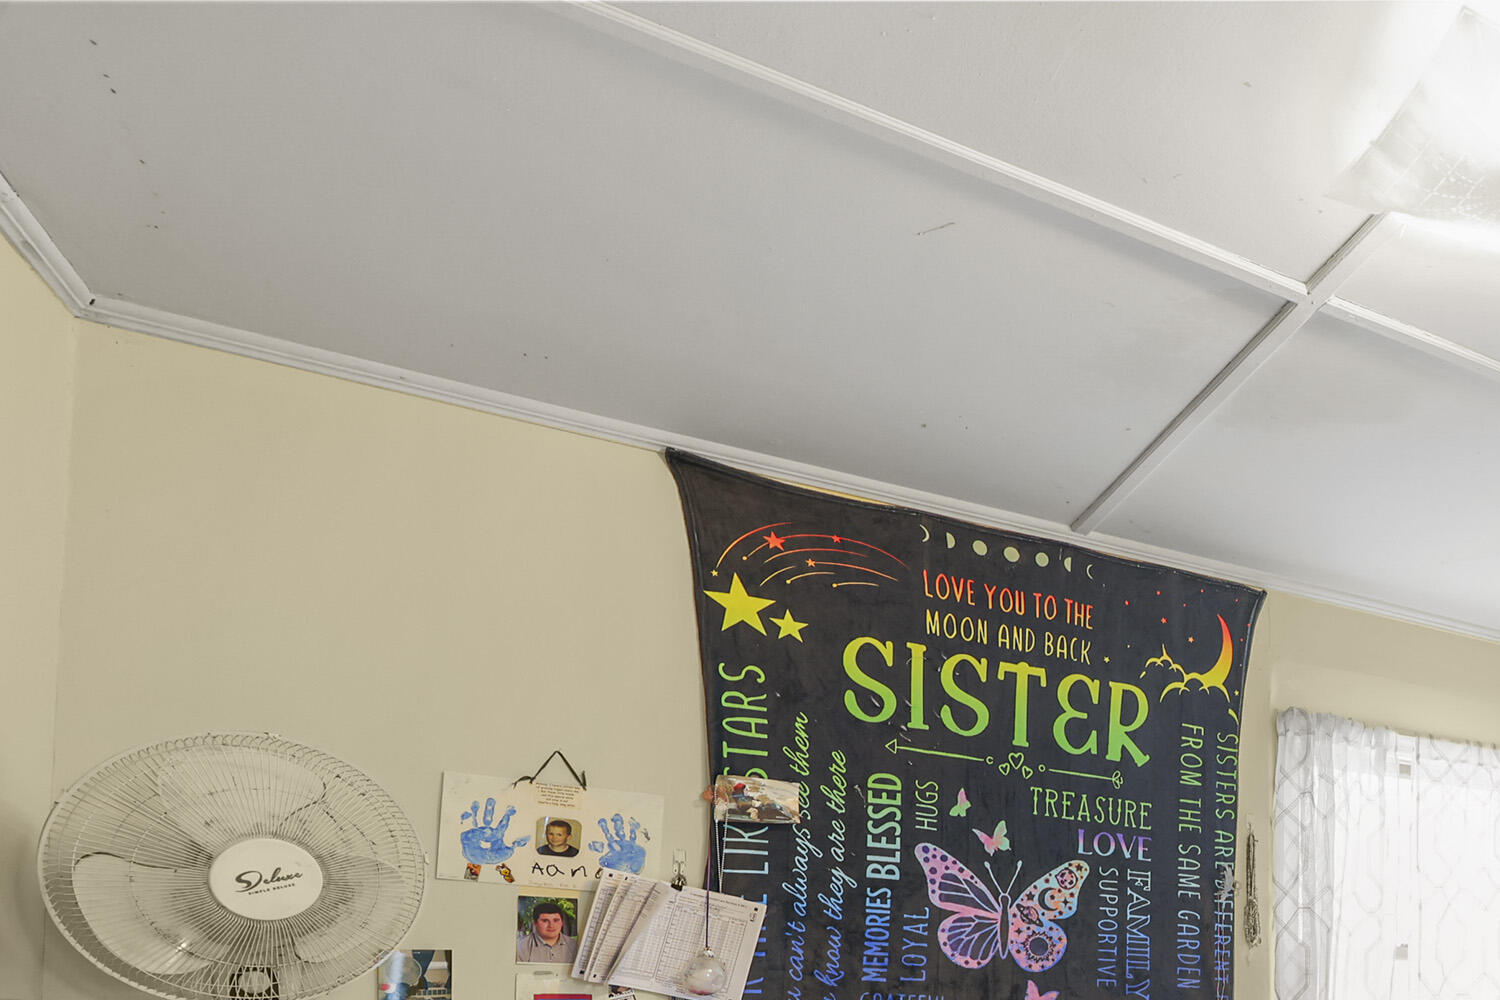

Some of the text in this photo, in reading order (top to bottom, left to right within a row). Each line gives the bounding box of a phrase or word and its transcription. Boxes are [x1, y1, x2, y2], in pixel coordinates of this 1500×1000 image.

[922, 568, 1094, 630] LOVE YOU TO THE
[925, 608, 1091, 665] MOON AND BACK
[717, 661, 769, 782] TARS
[842, 636, 1151, 767] SISTER
[782, 711, 811, 777] them
[1214, 731, 1239, 820] SISTERS
[819, 749, 848, 816] there
[913, 779, 939, 832] HUGS
[1029, 786, 1153, 831] TREASURE
[722, 823, 769, 875] LIK
[827, 819, 847, 863] are
[865, 772, 902, 881] BLESSED
[1076, 828, 1153, 862] LOVE
[1176, 722, 1205, 989] FROM THE SAME GARDEN
[1213, 829, 1235, 870] ARE
[781, 823, 824, 917] always
[817, 866, 858, 921] they
[784, 920, 807, 982] can't
[813, 925, 846, 988] know
[861, 886, 893, 983] MEMORIES
[899, 906, 930, 982] LOYAL
[1096, 865, 1119, 988] SUPPORTIVE
